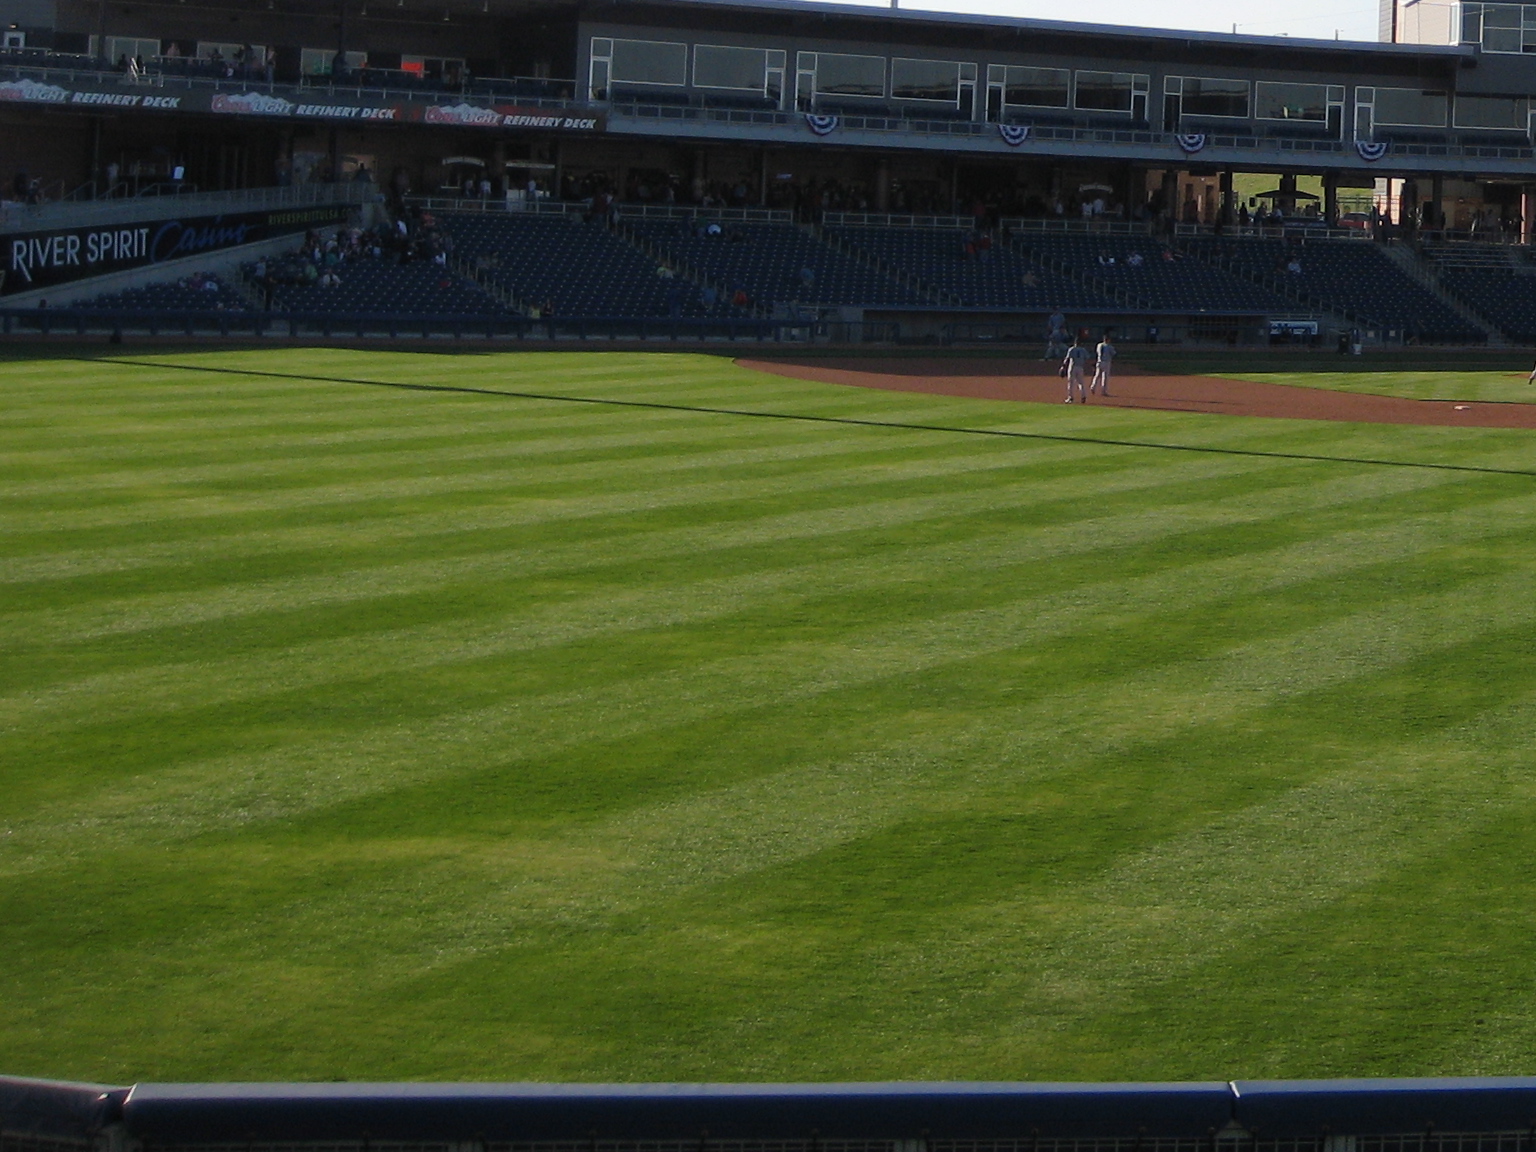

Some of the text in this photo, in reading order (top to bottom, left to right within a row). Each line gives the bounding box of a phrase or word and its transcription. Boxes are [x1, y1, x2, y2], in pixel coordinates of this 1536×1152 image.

[25, 88, 69, 102] LIGHT
[72, 91, 141, 106] REFINERY
[142, 96, 181, 108] DECK
[252, 99, 295, 114] LIGHT
[296, 104, 360, 118] REFINERY
[360, 107, 397, 119] DECK
[462, 112, 502, 124] LIGHT
[503, 115, 562, 128] REFINERY
[563, 118, 597, 129] DECK
[12, 235, 80, 282] RIVER
[87, 228, 149, 263] SPIRIT
